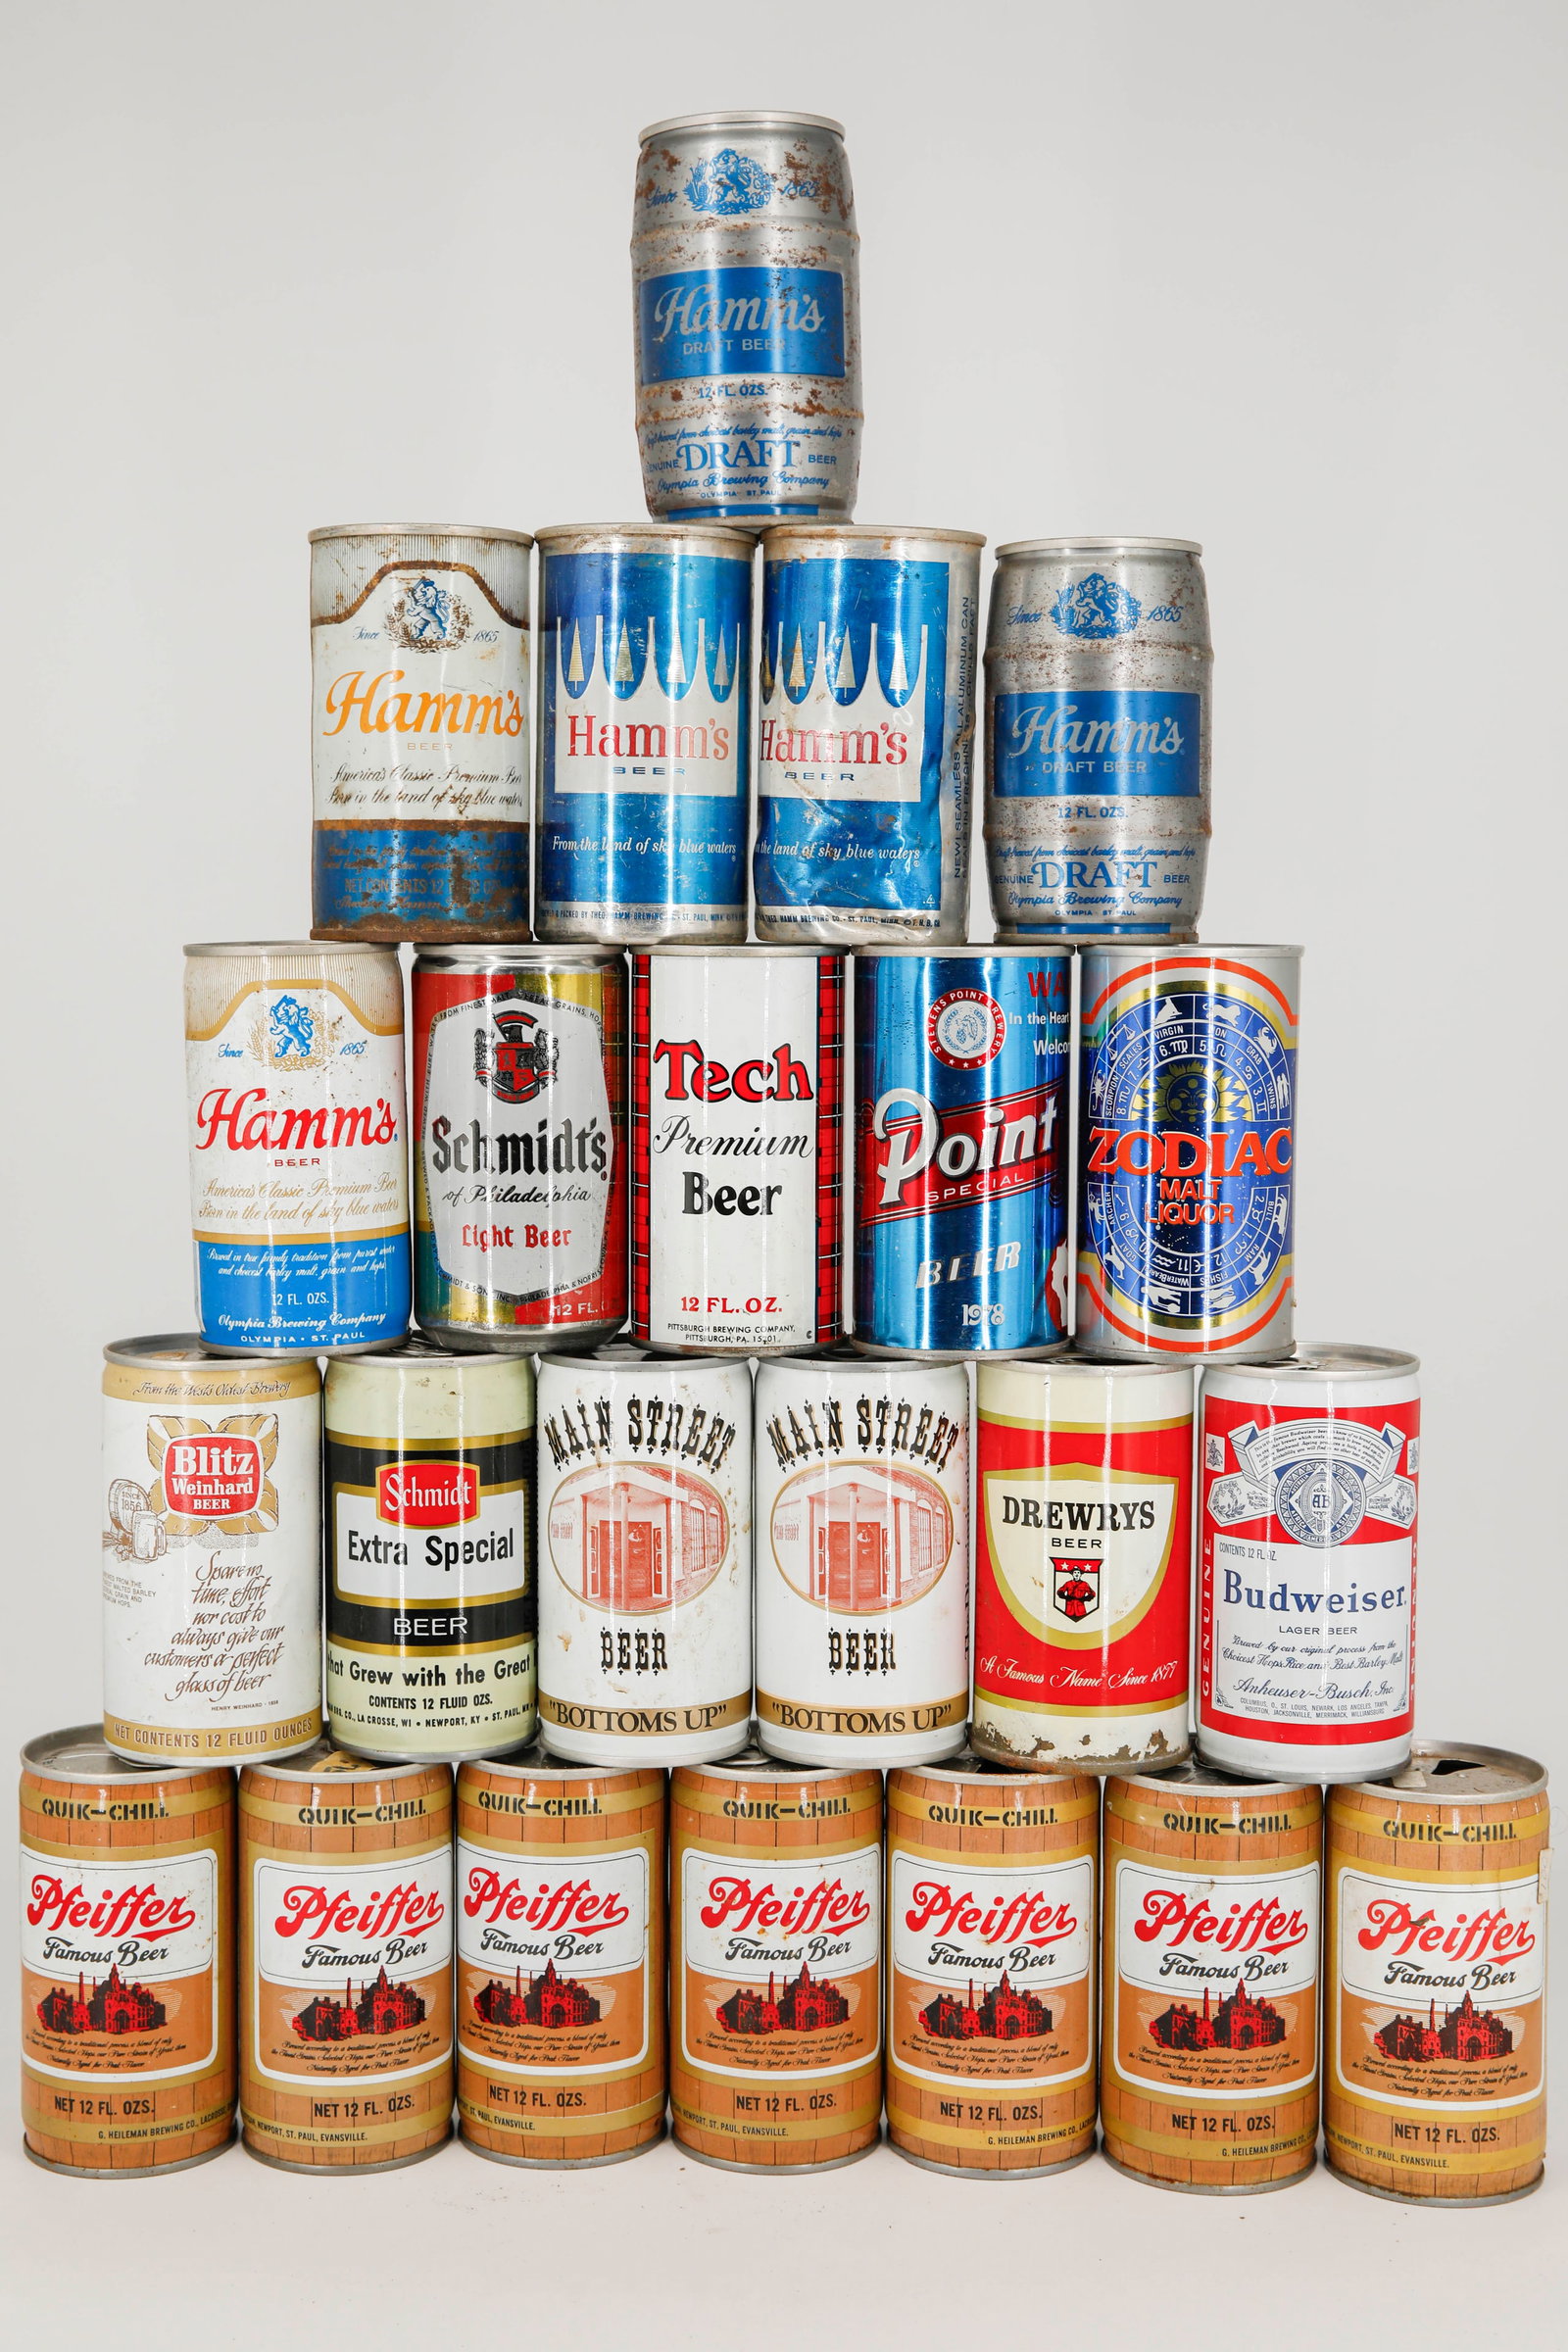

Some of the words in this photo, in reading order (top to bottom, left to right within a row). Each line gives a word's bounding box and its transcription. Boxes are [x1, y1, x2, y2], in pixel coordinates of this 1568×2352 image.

[654, 283, 826, 343] Hamm's
[683, 339, 734, 355] DRAFT
[742, 338, 786, 351] BEER
[675, 440, 802, 472] DRAFT
[808, 454, 837, 466] BEER
[353, 626, 380, 641] Since
[472, 629, 500, 644] 1865
[957, 636, 967, 717] ALUMINUM
[322, 669, 525, 737] Hamm's
[567, 714, 732, 762] Hamm's
[760, 719, 907, 764] Hamm's
[1006, 705, 1185, 759] Hamm's
[612, 766, 686, 775] BEER
[785, 772, 856, 782] BEER
[1043, 761, 1095, 774] DRAFT
[1103, 761, 1147, 773] BEER
[953, 752, 963, 832] SEAMLESS
[1058, 808, 1071, 819] 12
[1077, 807, 1096, 819] FL.
[1100, 807, 1128, 819] OZS.
[773, 843, 798, 859] land
[802, 844, 818, 863] of
[818, 845, 841, 864] sky
[843, 846, 874, 863] blue
[879, 847, 920, 867] waters
[1031, 861, 1157, 889] DRAFT
[1163, 874, 1190, 885] BEER
[928, 998, 948, 1054] STEVENS
[949, 991, 985, 1005] POINT
[986, 999, 1006, 1056] BREWERY
[1008, 1011, 1022, 1026] In
[1026, 1011, 1046, 1027] the
[1154, 1025, 1184, 1040] VIRGIN
[218, 1043, 244, 1058] Since
[339, 1041, 368, 1056] 1865
[1119, 1043, 1143, 1069] SCALES
[1246, 1045, 1261, 1065] CRAB
[654, 1039, 815, 1102] Tech
[1103, 1074, 1119, 1117] SCORPION
[195, 1087, 397, 1152] Hamm's
[432, 1115, 607, 1176] Schmidt's
[653, 1115, 814, 1158] Premium
[873, 1087, 1057, 1209] Point
[1088, 1125, 1294, 1178] ZODIAC
[274, 1157, 321, 1168] BEER
[441, 1187, 464, 1208] of
[464, 1184, 592, 1209] Philadelphia
[682, 1171, 783, 1216] Beer
[927, 1173, 1025, 1202] SPECIAL
[1159, 1179, 1223, 1200] MALT
[1144, 1201, 1235, 1227] LIQUOR
[462, 1224, 514, 1253] Light
[525, 1224, 572, 1249] Beer
[915, 1241, 1022, 1290] BEER
[681, 1297, 700, 1312] 12
[707, 1297, 740, 1313] FL.
[745, 1297, 783, 1313] OZ.
[961, 1302, 1006, 1327] 1978
[218, 1314, 266, 1331] Olympia
[267, 1313, 326, 1333] Brewing
[328, 1311, 386, 1330] Company
[667, 1323, 710, 1334] PITTSBURGH
[712, 1325, 752, 1335] BREWING
[755, 1324, 796, 1335] COMPANY,
[543, 1396, 616, 1472] MAIN
[625, 1394, 737, 1475] STREET
[766, 1396, 845, 1473] MAIN
[856, 1394, 960, 1474] STREET
[172, 1445, 255, 1477] Blitz
[172, 1478, 255, 1497] Weinhard
[384, 1473, 472, 1512] Schmidt
[193, 1498, 231, 1511] BEER
[1002, 1494, 1156, 1532] DREWRYS
[348, 1529, 409, 1566] Extra
[424, 1527, 514, 1572] Special
[1051, 1538, 1102, 1549] BEER
[1218, 1542, 1247, 1559] CONTENTS
[1248, 1545, 1255, 1559] 12
[195, 1549, 247, 1587] Spare
[247, 1563, 263, 1578] no
[1223, 1568, 1407, 1614] Budweiser
[171, 1627, 225, 1652] always
[225, 1625, 260, 1653] give
[260, 1625, 285, 1642] our
[393, 1617, 468, 1637] BEER
[1279, 1625, 1320, 1636] LAGER
[1327, 1626, 1358, 1636] BEER
[600, 1626, 668, 1676] BEER
[827, 1627, 896, 1676] BEER
[350, 1661, 393, 1686] Grew
[403, 1664, 446, 1687] with
[456, 1662, 485, 1686] the
[494, 1654, 530, 1680] Great
[980, 1655, 999, 1675] A
[997, 1658, 1046, 1685] Famous
[1050, 1666, 1103, 1688] Name
[1107, 1667, 1148, 1689] Since
[1150, 1660, 1179, 1683] 1877
[368, 1694, 416, 1710] CONTENTS
[422, 1698, 435, 1710] 12
[439, 1695, 467, 1710] FLUID
[473, 1692, 494, 1708] OZS.
[549, 1699, 678, 1734] "BOTTOMS
[683, 1703, 728, 1730] UP"
[115, 1724, 130, 1740] NET
[134, 1729, 200, 1748] CONTENTS
[207, 1735, 221, 1748] 12
[229, 1731, 267, 1747] FLUID
[273, 1718, 313, 1739] OUNCES
[425, 1717, 468, 1728] NEWPORT,
[470, 1715, 481, 1725] KY
[772, 1701, 906, 1735] "BOTTOMS
[911, 1703, 953, 1732] UP"
[26, 1873, 196, 1943] Pfeiffer
[274, 1880, 445, 1940] Pfeiffer
[464, 1866, 629, 1937] Pfeiffer
[700, 1876, 870, 1937] Pfeiffer
[905, 1881, 1077, 1949] Pfeiffer
[1134, 1888, 1308, 1956] Pfeiffer
[1357, 1898, 1536, 1967] Pfeiffer
[42, 1936, 116, 1964] Famous
[117, 1939, 170, 1967] Beer
[302, 1943, 382, 1969] Famous
[384, 1937, 429, 1965] Beer
[480, 1928, 551, 1957] Famous
[554, 1934, 605, 1961] Beer
[724, 1936, 805, 1962] Famous
[808, 1936, 853, 1963] Beer
[927, 1941, 1005, 1970] Famous
[1008, 1945, 1057, 1973] Beer
[1158, 1952, 1241, 1980] Famous
[1244, 1954, 1290, 1982] Beer
[1383, 1960, 1468, 1988] Famous
[1470, 1963, 1517, 1991] Beer
[315, 2102, 339, 2119] NET
[344, 2101, 359, 2118] 12
[365, 2101, 384, 2117] FL.
[388, 2094, 416, 2113] OZS.
[108, 2128, 148, 2140] HEILEMAN
[150, 2122, 184, 2137] BREWING
[320, 2132, 368, 2142] EVANSVILLE.
